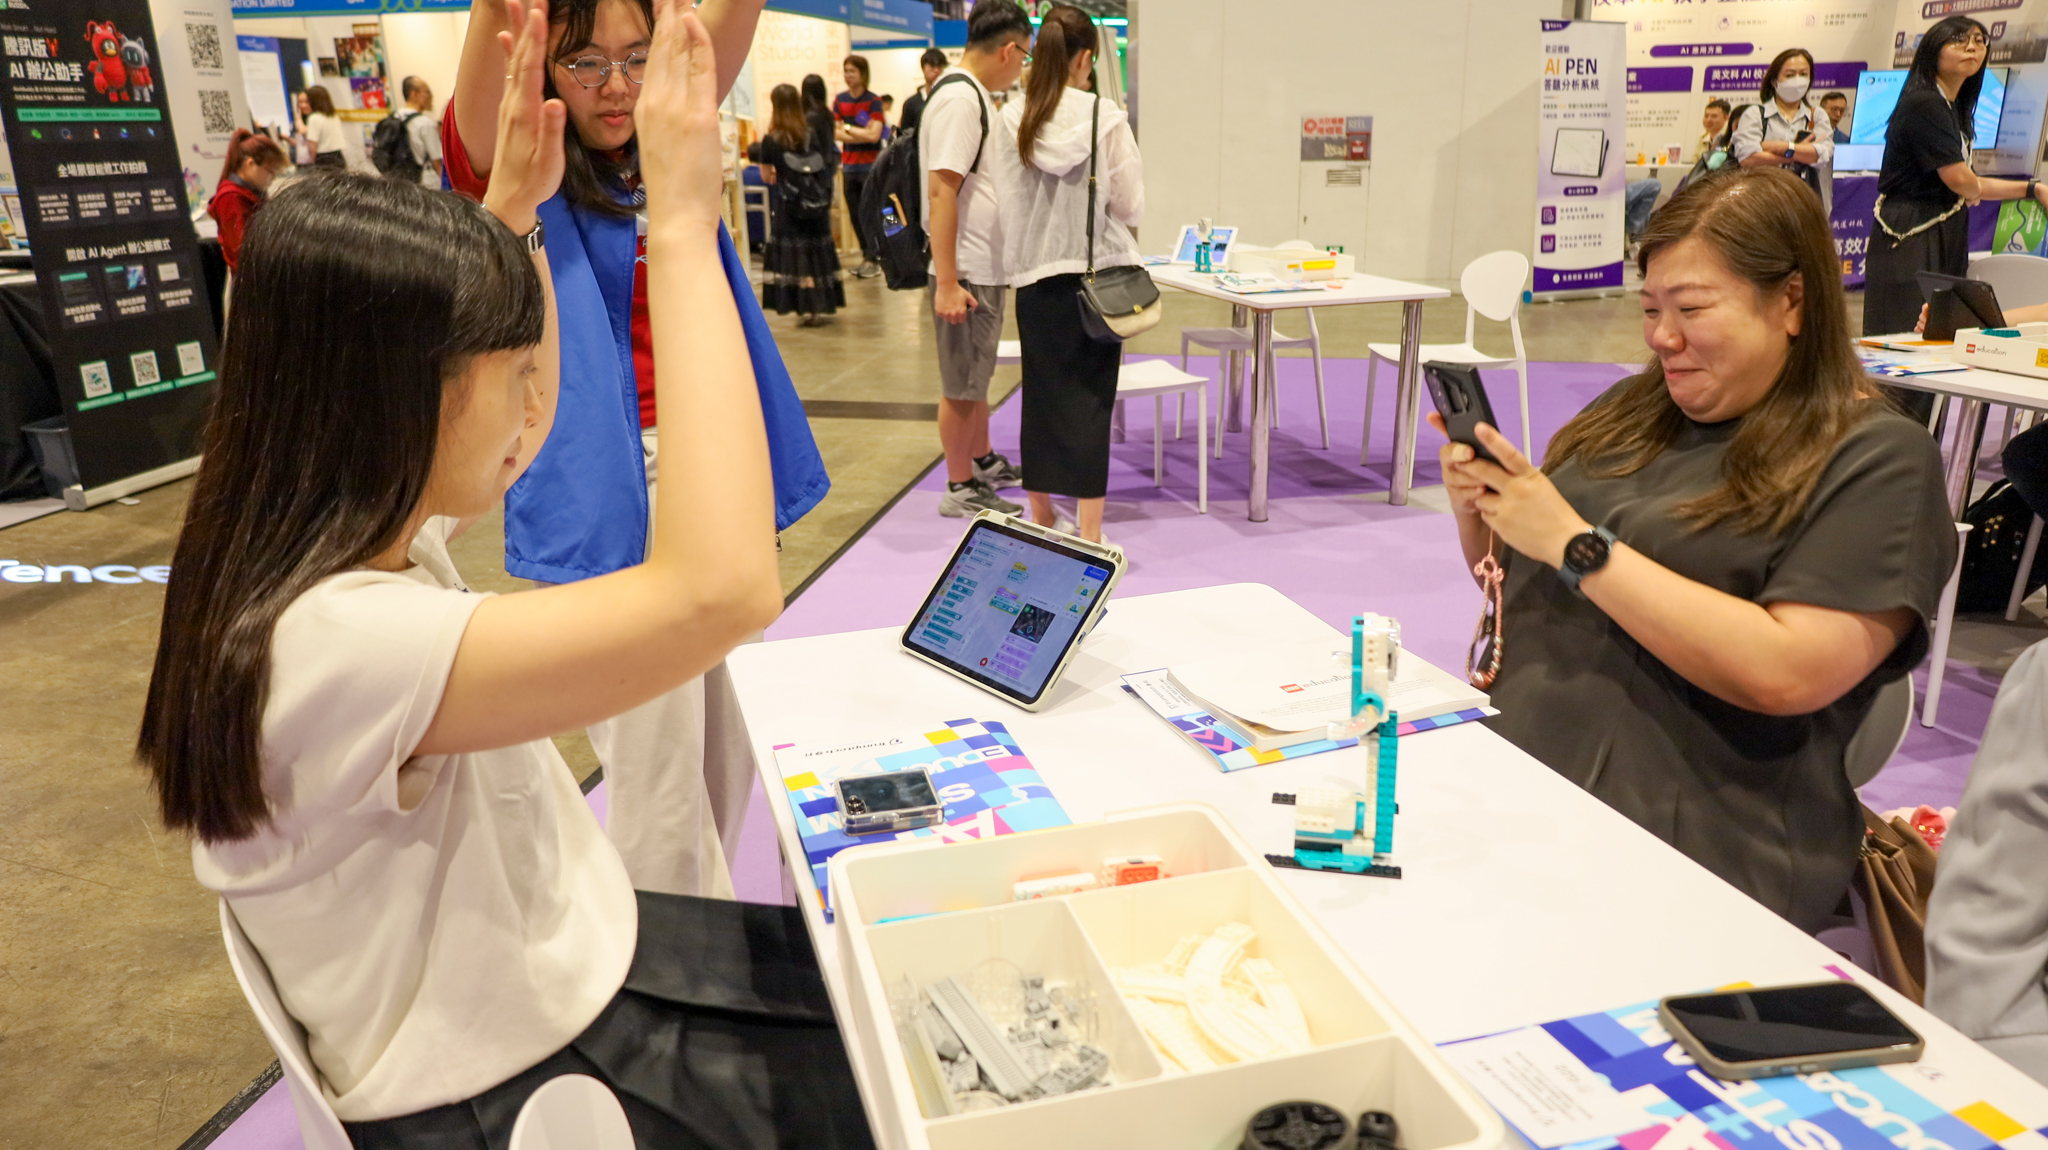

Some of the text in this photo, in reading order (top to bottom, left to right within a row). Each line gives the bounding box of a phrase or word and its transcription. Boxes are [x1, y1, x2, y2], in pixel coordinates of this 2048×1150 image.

[10, 60, 84, 82] AI 辦公助手
[1544, 58, 1597, 75] AI PEN
[1753, 68, 1767, 79] 校
[88, 247, 99, 259] AI
[100, 244, 128, 260] Agent
[1977, 346, 2006, 355] education
[1302, 673, 1352, 688] educatio
